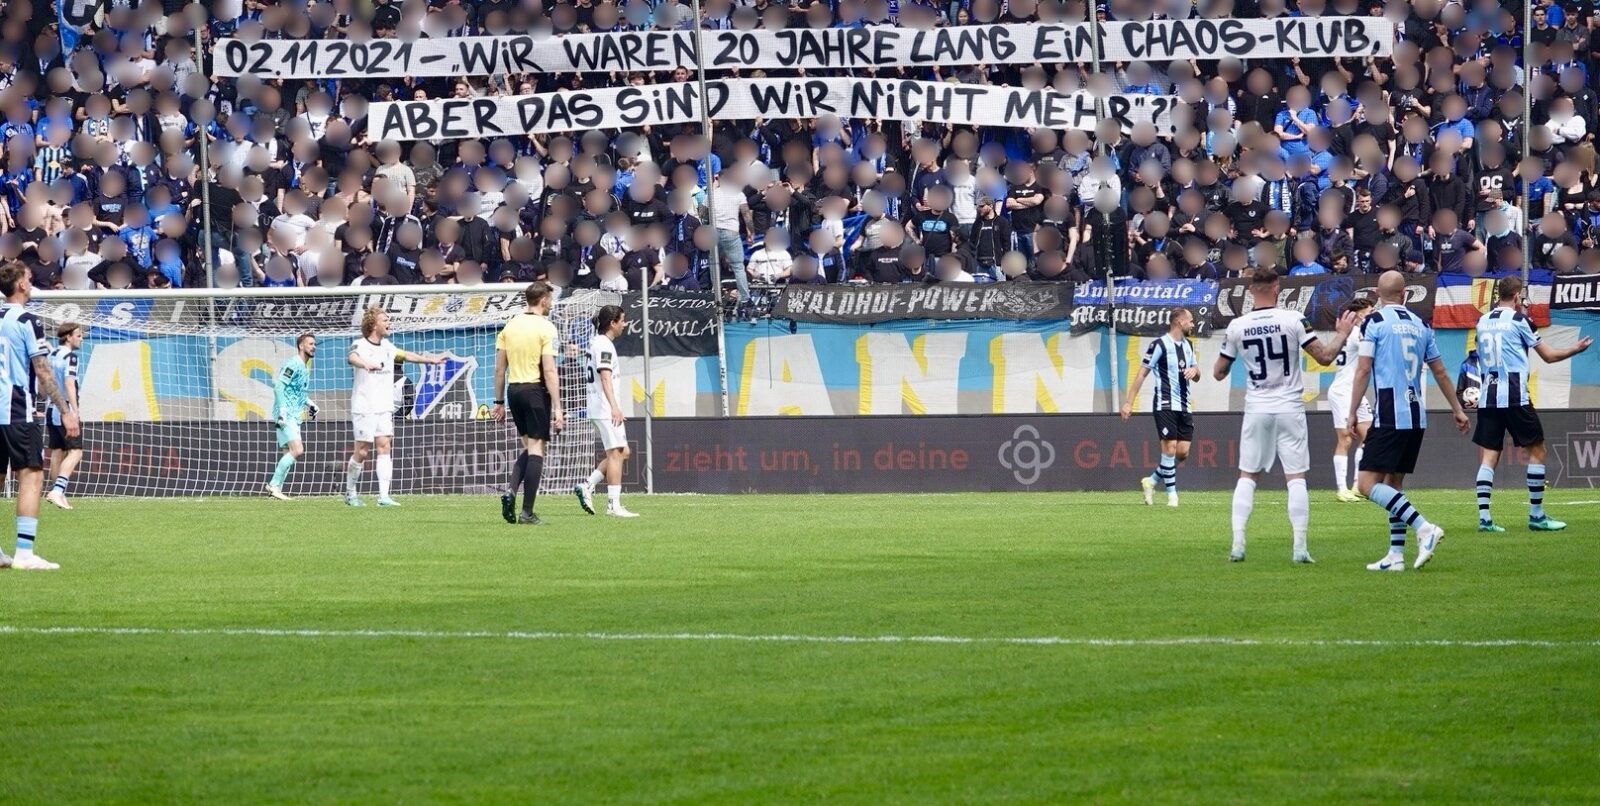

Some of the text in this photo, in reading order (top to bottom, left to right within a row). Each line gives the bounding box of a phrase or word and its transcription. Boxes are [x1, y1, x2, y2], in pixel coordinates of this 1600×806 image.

[226, 41, 410, 75] 02.11.2021
[563, 33, 698, 69] WAREN
[713, 33, 760, 66] 20
[775, 29, 901, 67] JAHRE
[911, 26, 1010, 62] LANG
[1121, 19, 1381, 58] CHAOS-KLUB,
[382, 102, 504, 140] ABER
[517, 96, 603, 133] DAS
[1555, 282, 1600, 304] KOL
[1244, 324, 1281, 336] HOBSCH
[1480, 332, 1503, 368] 31
[1242, 334, 1290, 381] 34
[1401, 337, 1419, 381] 5
[665, 439, 1237, 476] zieht um, in deine GALRI
